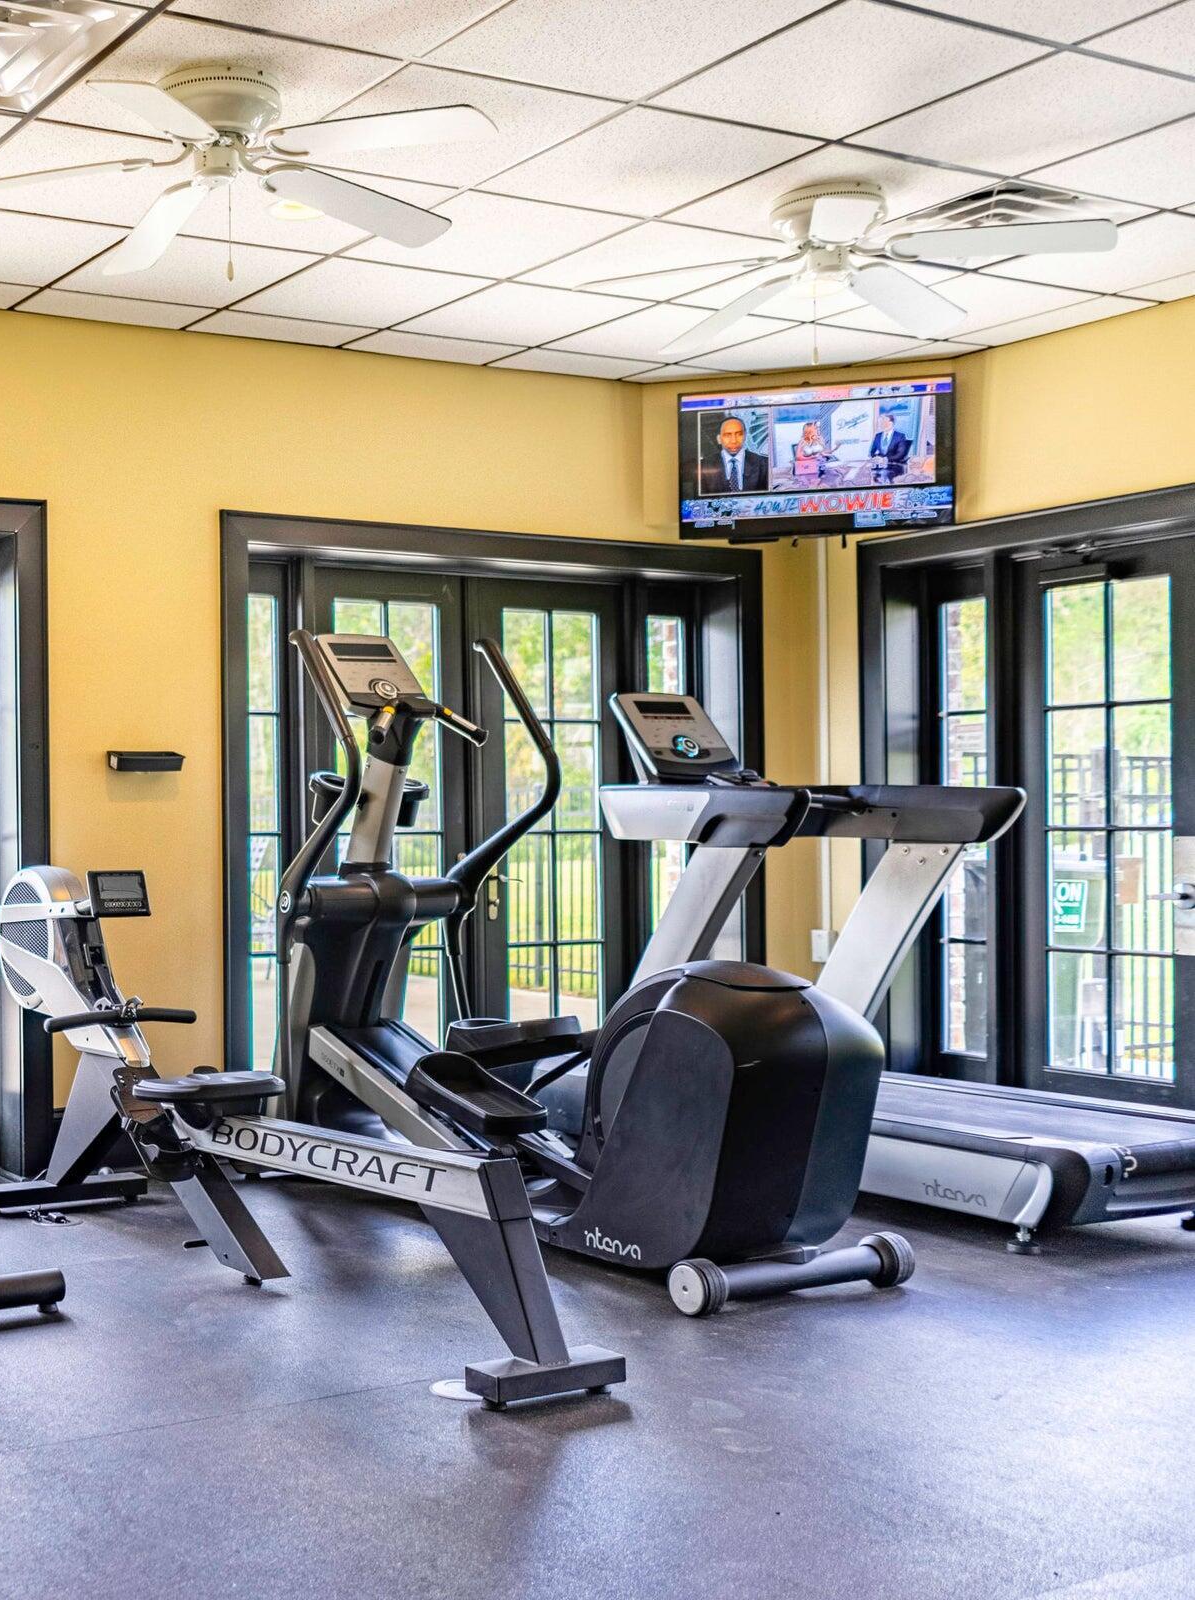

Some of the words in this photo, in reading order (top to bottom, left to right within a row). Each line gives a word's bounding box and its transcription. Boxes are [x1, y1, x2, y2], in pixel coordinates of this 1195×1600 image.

[799, 491, 894, 514] WOWIE
[1054, 882, 1082, 902] ON
[211, 1123, 447, 1192] BODYCRAFT
